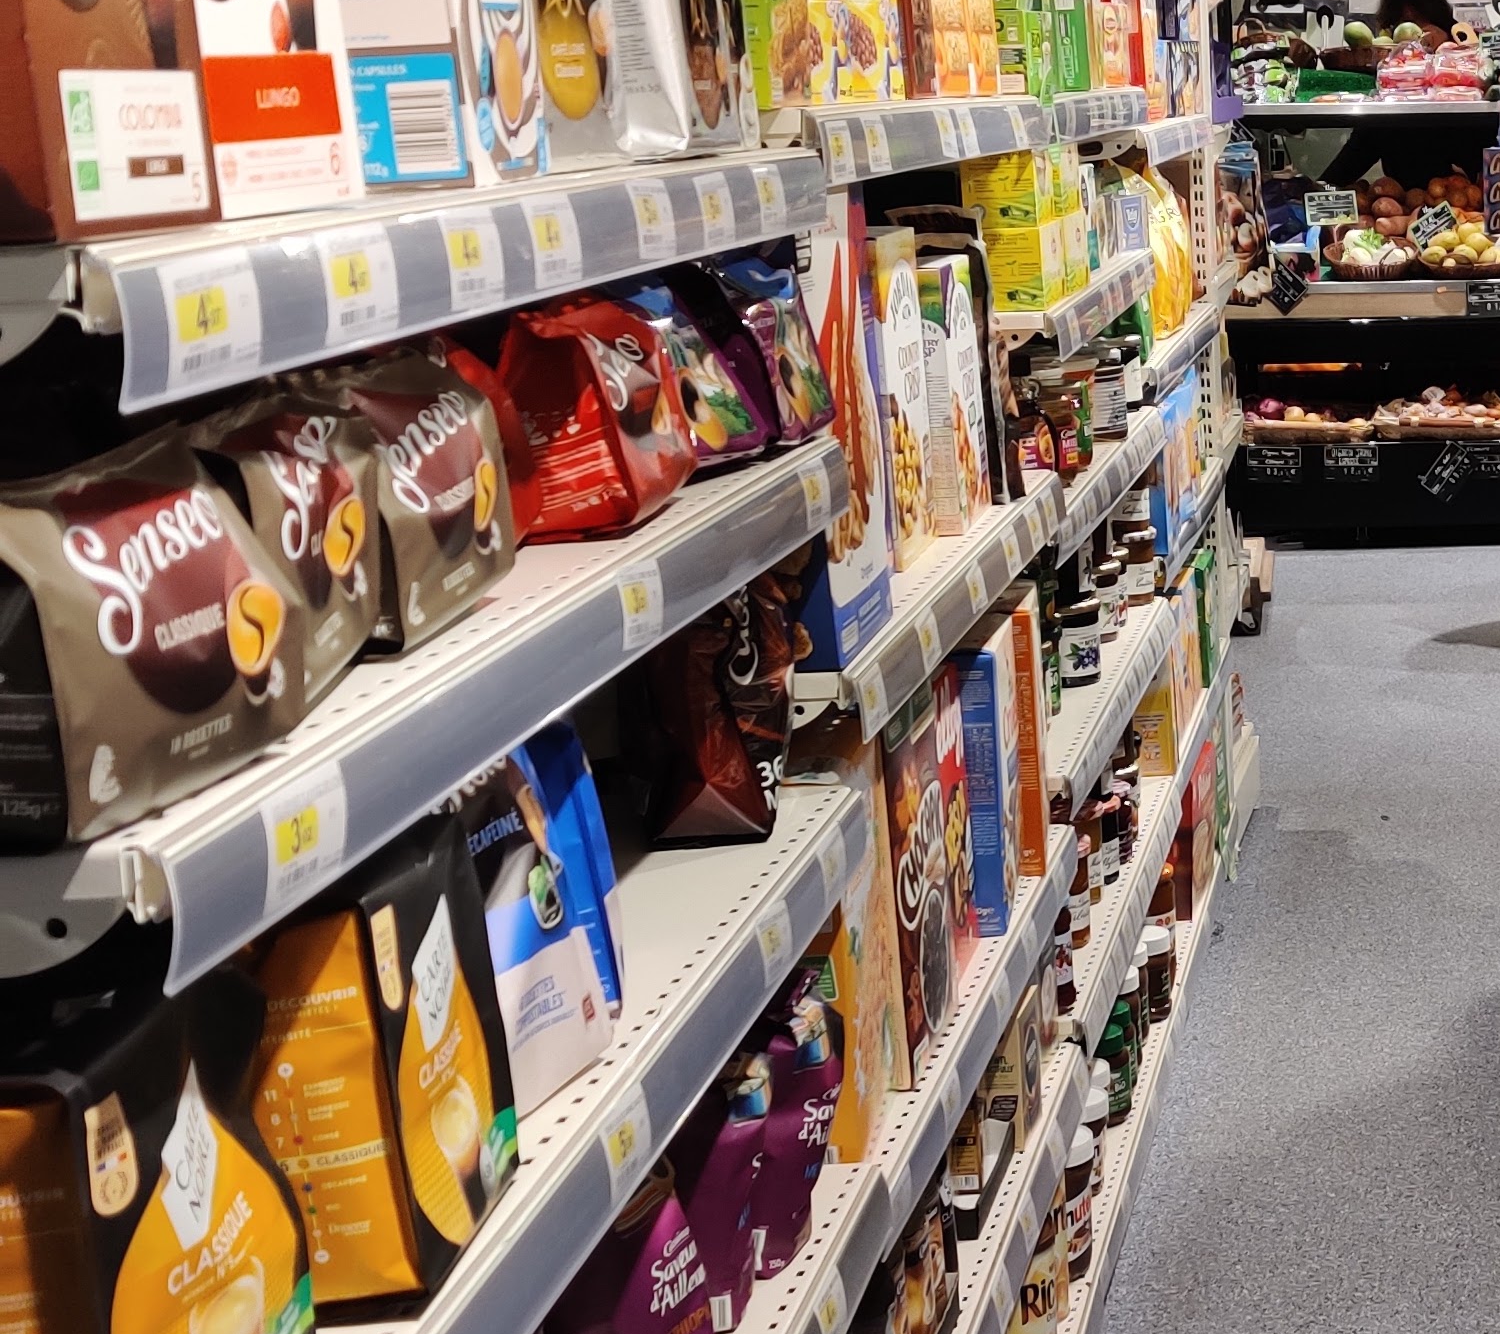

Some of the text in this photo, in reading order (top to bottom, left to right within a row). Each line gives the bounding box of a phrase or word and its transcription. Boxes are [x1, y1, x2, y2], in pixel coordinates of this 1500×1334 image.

[256, 86, 300, 110] LUNGO
[62, 489, 225, 656] Senseo
[154, 601, 226, 652] CLASSIQUE
[420, 930, 449, 1004] CARTE
[174, 1096, 205, 1193] CARTE
[188, 1139, 213, 1225] NOIRE
[315, 1141, 389, 1168] CLASSIQUE
[167, 1191, 254, 1296] CLASSIQUE
